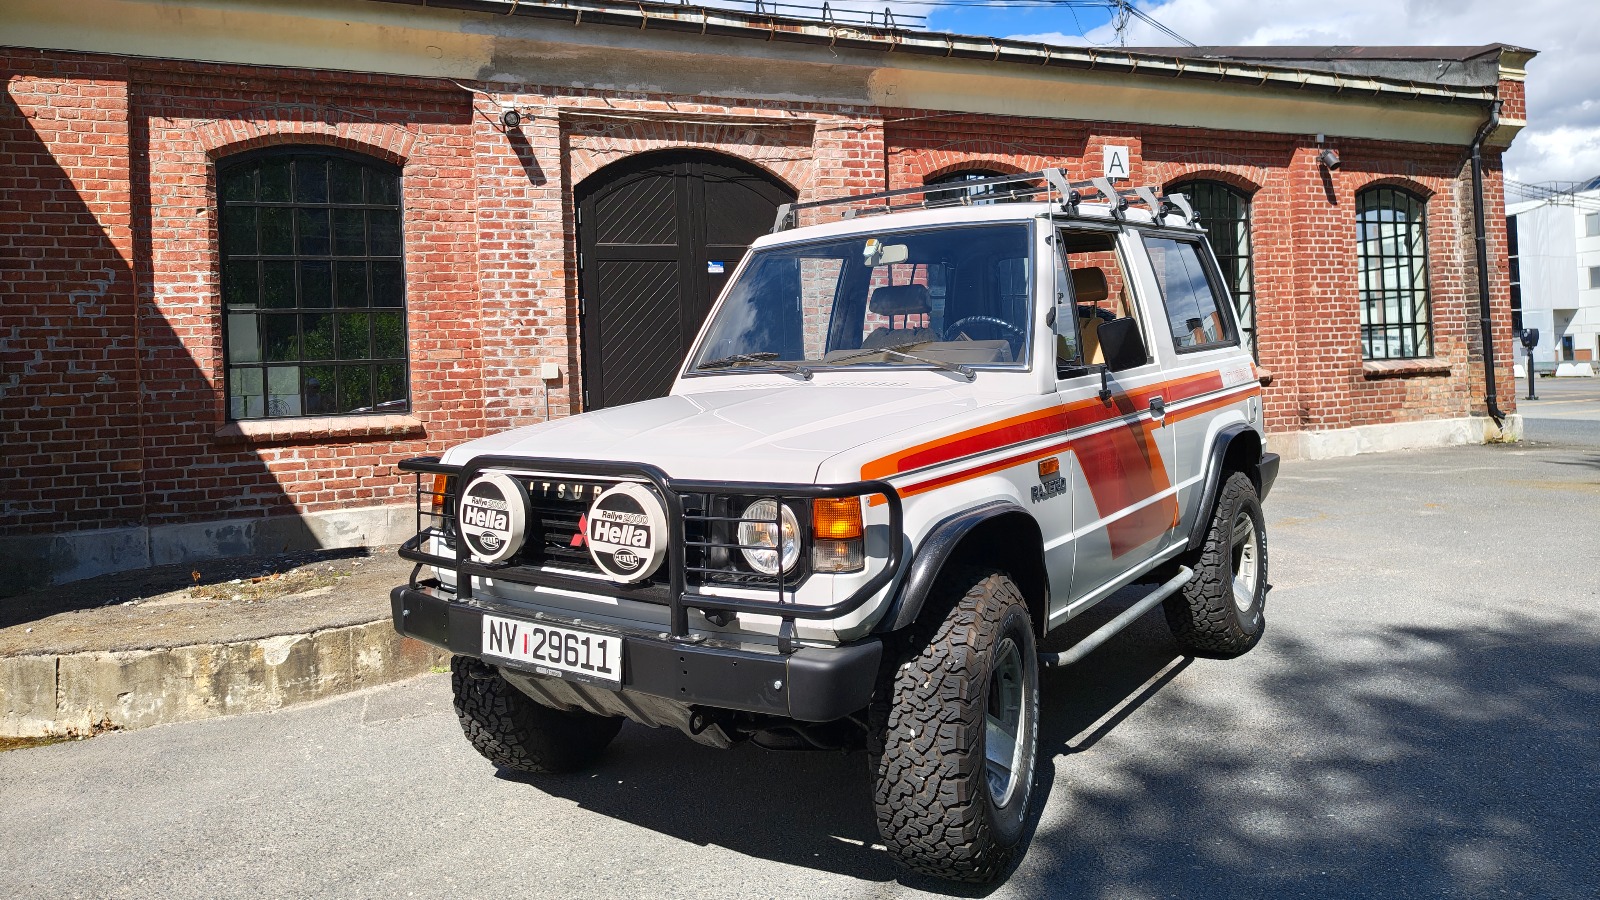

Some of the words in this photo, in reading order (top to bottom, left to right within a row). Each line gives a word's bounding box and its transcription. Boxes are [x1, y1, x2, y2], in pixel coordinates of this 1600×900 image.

[1109, 151, 1125, 173] A
[529, 481, 603, 500] ITSUB
[465, 505, 507, 530] Hella
[602, 510, 623, 521] Rallye
[623, 513, 649, 524] 2000
[594, 520, 648, 547] Hella
[615, 554, 639, 565] HELLA
[489, 620, 518, 655] NV
[532, 627, 612, 674] 29611
